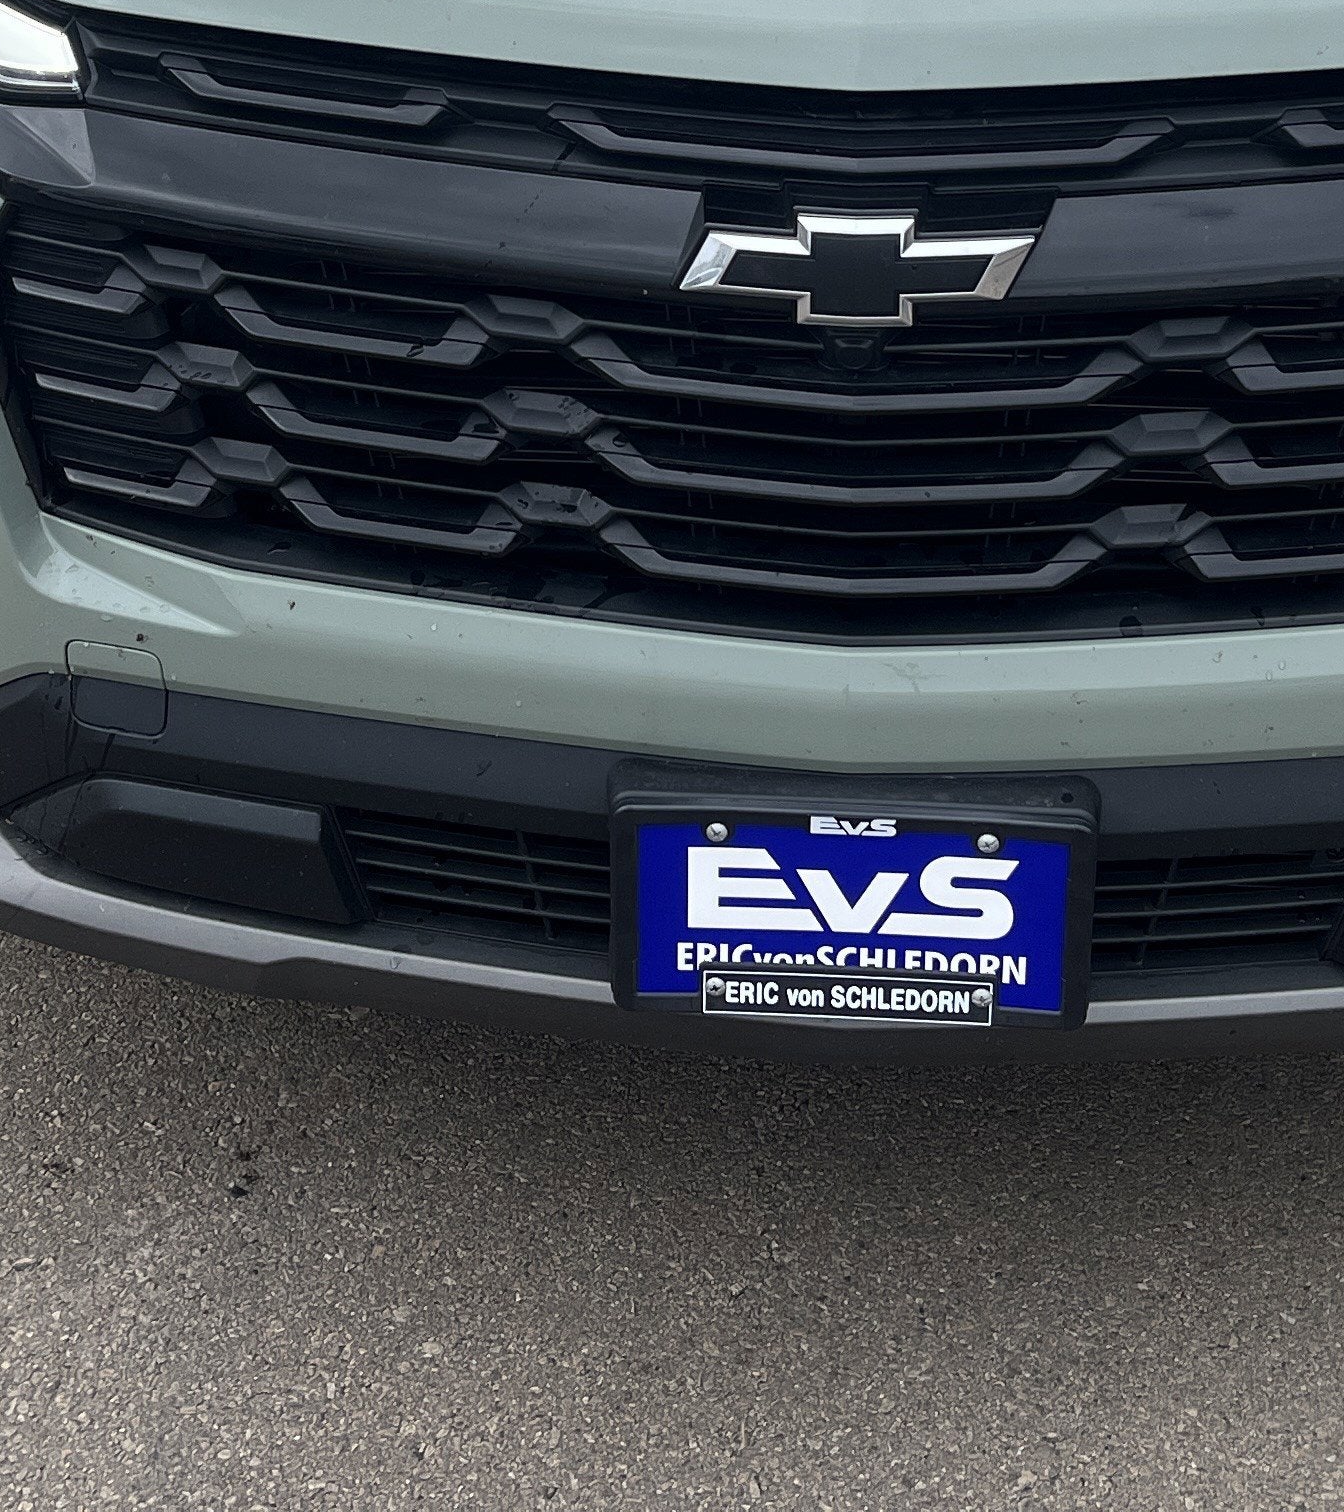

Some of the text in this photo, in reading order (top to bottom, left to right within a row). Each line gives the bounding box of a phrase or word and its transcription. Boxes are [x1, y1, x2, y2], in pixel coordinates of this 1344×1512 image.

[725, 980, 971, 1014] ERIC von SCHLEDORN
